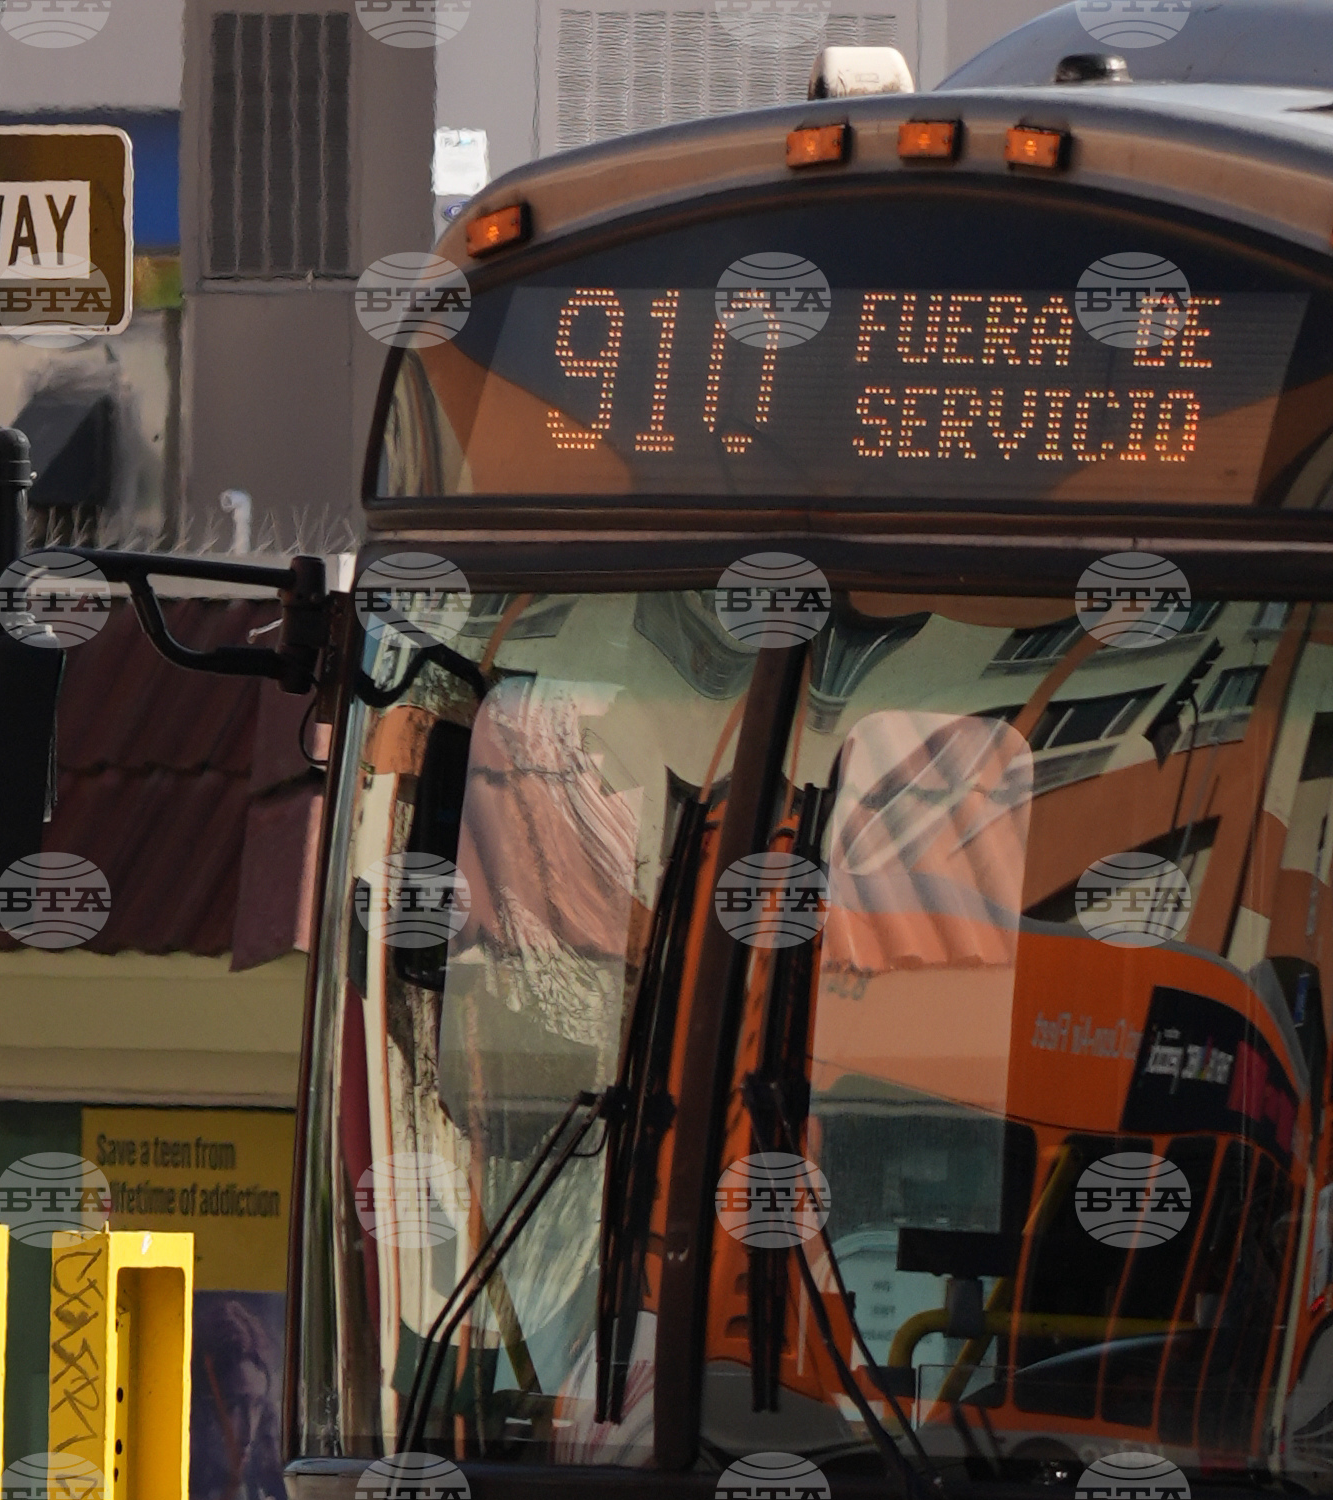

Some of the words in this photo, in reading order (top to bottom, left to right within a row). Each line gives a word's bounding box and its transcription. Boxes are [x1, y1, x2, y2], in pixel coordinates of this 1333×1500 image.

[545, 287, 782, 454] 910
[854, 292, 1075, 368] FUERA
[1131, 296, 1223, 370] DE
[852, 387, 1201, 463] SERVICIO
[96, 1132, 136, 1167] Save
[140, 1142, 150, 1167] a
[153, 1137, 191, 1168] teen
[195, 1137, 236, 1169] from
